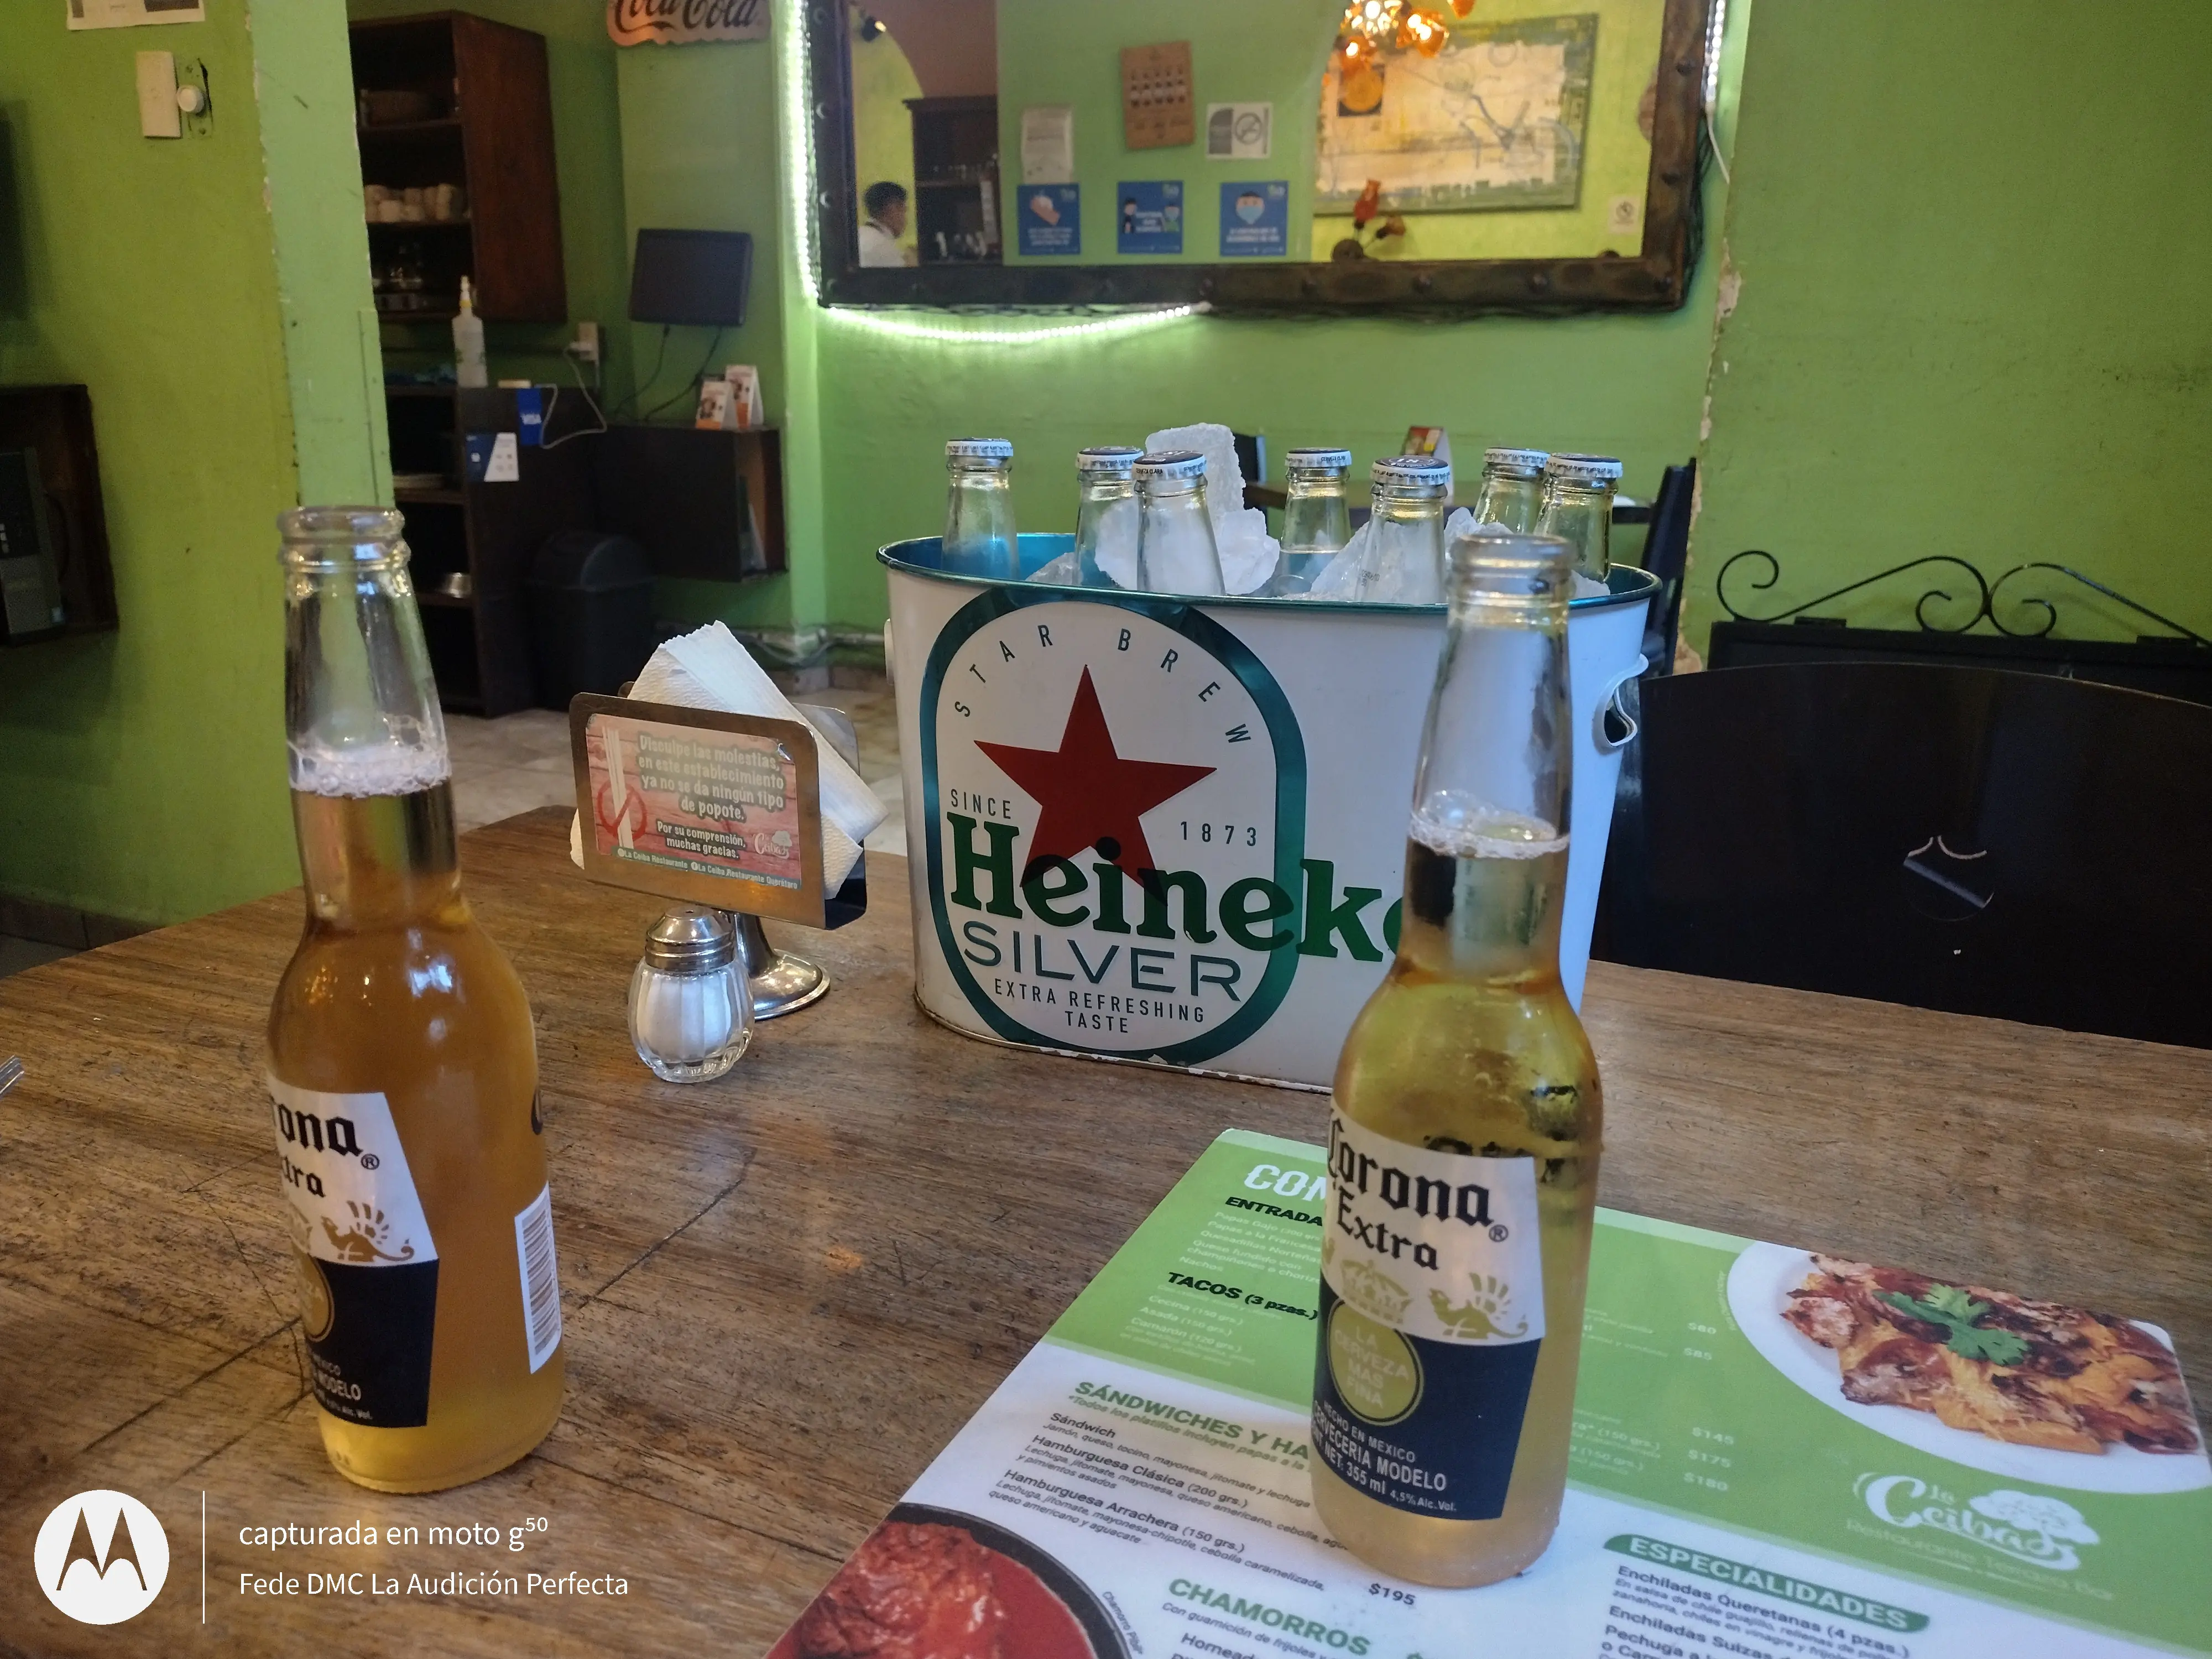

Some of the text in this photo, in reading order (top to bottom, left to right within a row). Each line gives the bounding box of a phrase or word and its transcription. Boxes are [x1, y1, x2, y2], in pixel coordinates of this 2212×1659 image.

[954, 624, 1252, 745] STAR BREW
[640, 735, 780, 771] Disculpe las molestias,
[638, 757, 784, 790] en este establecimiento
[641, 775, 784, 810] ya no se da ningún tipo
[681, 796, 744, 821] de popote.
[657, 821, 747, 848] Por su comprensión,
[950, 789, 1258, 847] SINCE 1873
[623, 849, 688, 869] La Ceiba Restaurante
[666, 837, 739, 859] muchas gracias.
[697, 864, 707, 873] La
[707, 865, 726, 877] Ceiba
[727, 868, 765, 883] Restaurante
[963, 919, 1242, 1003] SILVER
[995, 981, 1204, 1023] EXTRA REFRESHING
[1065, 1010, 1129, 1034] TASTE
[1208, 1220, 1243, 1234] Papas
[1255, 1231, 1266, 1239] la
[1224, 1196, 1323, 1227] ENTRADA
[1337, 1185, 1439, 1271] Extra
[1187, 1247, 1266, 1270] champiñones
[1193, 1239, 1230, 1253] Queso
[1232, 1248, 1277, 1264] fundido
[1200, 1230, 1266, 1251] Quesadillas
[1179, 1256, 1224, 1272] Nachos
[1167, 1271, 1243, 1300] TACOS
[1244, 1293, 1264, 1305] (3
[1267, 1299, 1319, 1321] pzas.)
[1356, 1326, 1378, 1346] LA
[1334, 1329, 1409, 1381] CERVEZA
[1348, 1358, 1384, 1389] MAS
[1347, 1375, 1383, 1410] FINA
[1050, 1412, 1116, 1438] Sándwich
[1075, 1381, 1309, 1460] SÁNDWICHES Y HA
[1110, 1404, 1130, 1419] los
[1129, 1414, 1181, 1434] platillos
[1182, 1427, 1236, 1451] incluyen
[1237, 1445, 1279, 1463] papas
[1280, 1458, 1290, 1467] a
[1291, 1459, 1305, 1470] la
[1323, 1400, 1416, 1463] HECHO EN MEXICO
[1024, 1456, 1078, 1477] pimientos
[1077, 1472, 1118, 1489] asados
[1032, 1434, 1248, 1509] Hamburguesa Clásica (200 grs.)
[1042, 1423, 1078, 1438] Jamón,
[1081, 1434, 1114, 1449] queso,
[1117, 1443, 1150, 1460] tocino,
[1210, 1472, 1256, 1492] jitomate
[1266, 1489, 1311, 1508] lechuga
[1346, 1461, 1367, 1485] 355
[1369, 1477, 1386, 1495] ml
[1376, 1455, 1447, 1492] MODELO
[1004, 1469, 1245, 1553] Hamburguesa Arrachera (150 grs.)
[1024, 1444, 1319, 1542] Lechuga, jitomate, mayonesa, queso americano, cebolla,
[988, 1490, 1022, 1505] queso
[1022, 1501, 1079, 1524] americano
[1089, 1522, 1142, 1543] aguacate
[995, 1479, 1324, 1592] Lechuga, jitomate, mayonesa-chipotle, cebolla caramelizada,
[1369, 1582, 1416, 1605] $195
[1618, 1564, 1712, 1601] Enchiladas
[1717, 1594, 1821, 1632] Queretanas
[1629, 1537, 1908, 1629] ESPECIALIDADES
[1162, 1602, 1187, 1616] Con
[1187, 1612, 1253, 1639] guarnición
[1254, 1632, 1271, 1644] de
[1168, 1578, 1372, 1656] CHAMORROS
[1609, 1604, 1707, 1643] Enchiladas
[1605, 1624, 1684, 1657] Pechuga
